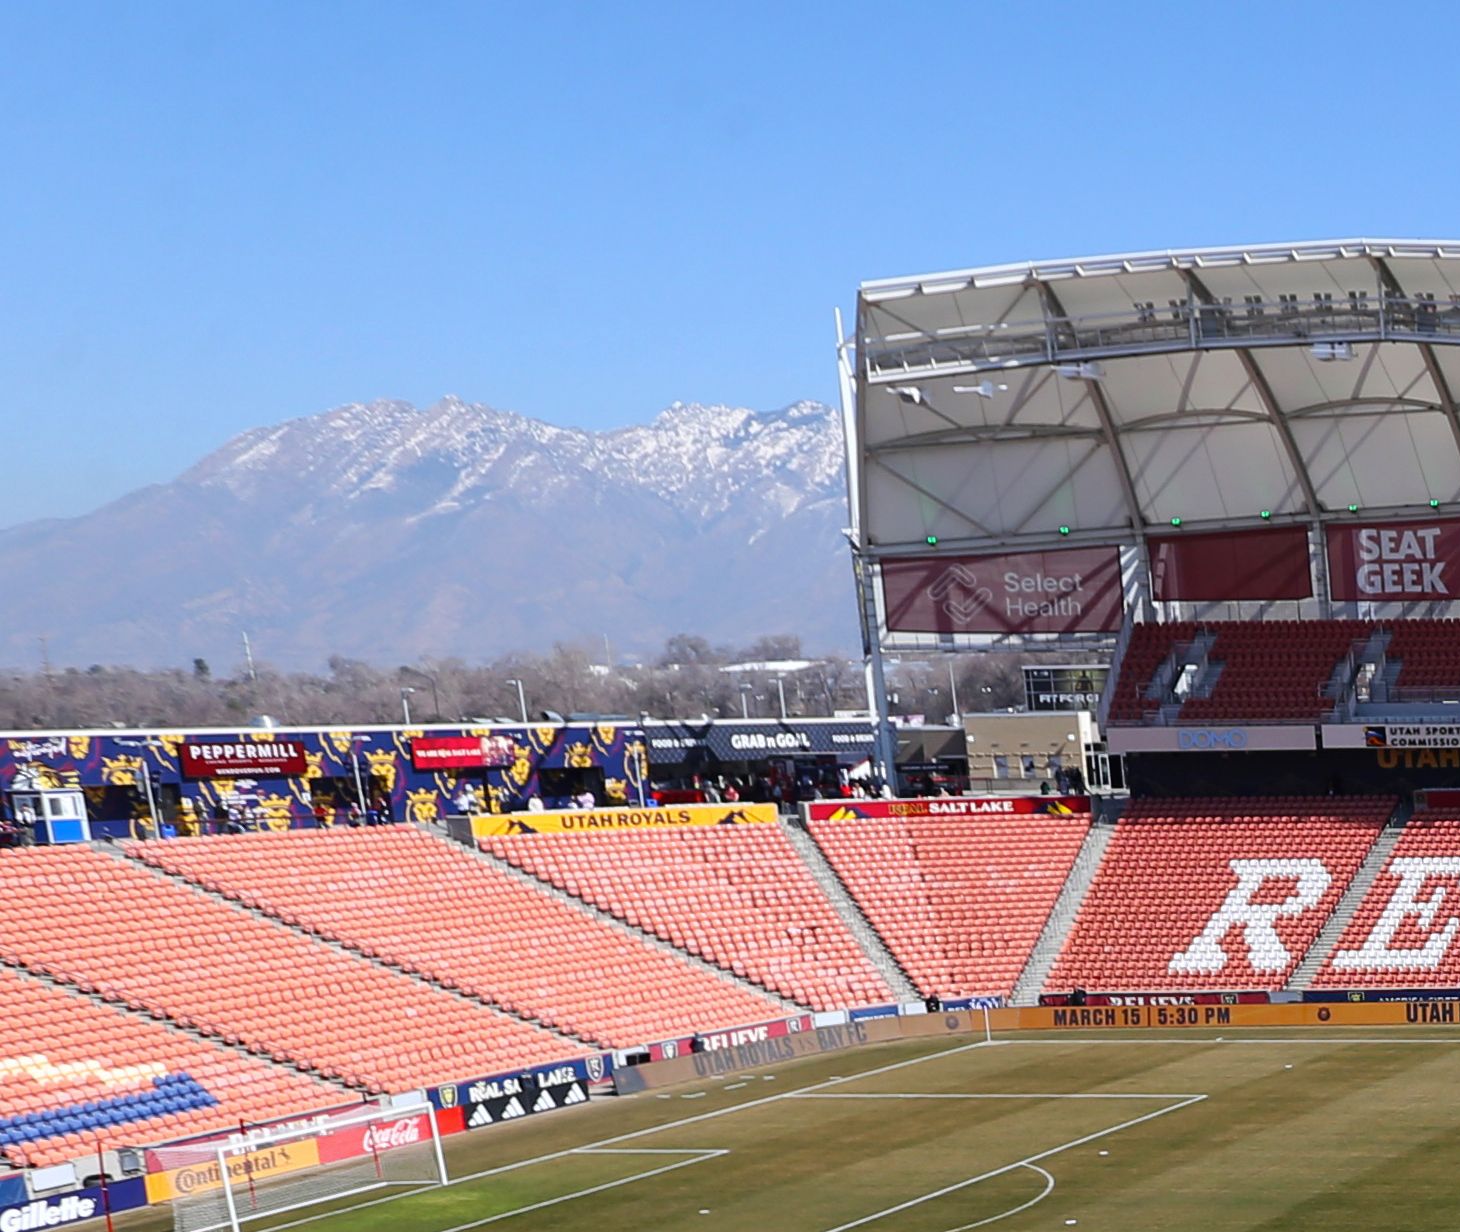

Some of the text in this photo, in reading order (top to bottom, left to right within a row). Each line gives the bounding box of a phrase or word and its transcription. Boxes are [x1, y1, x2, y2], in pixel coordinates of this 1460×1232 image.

[1360, 528, 1441, 560] SEAT
[1004, 572, 1083, 592] Select
[1357, 561, 1449, 593] GEEK
[1006, 596, 1081, 616] Health
[1178, 729, 1247, 749] DOMO
[1390, 726, 1421, 736] UTAH
[189, 744, 298, 759] PEPPERMILL
[732, 734, 765, 749] GRAB
[1377, 748, 1460, 769] UTAH
[929, 801, 970, 814] SALT
[970, 801, 1014, 813] LAKE
[562, 810, 691, 829] UTAH ROYALS
[1054, 1007, 1231, 1026] MARCH 15 5:30 PM
[1406, 1002, 1454, 1022] UTAH
[692, 1045, 736, 1072] UTAH
[739, 1039, 794, 1067] ROYALS
[817, 1026, 845, 1050] BAY
[849, 1021, 867, 1043] FC
